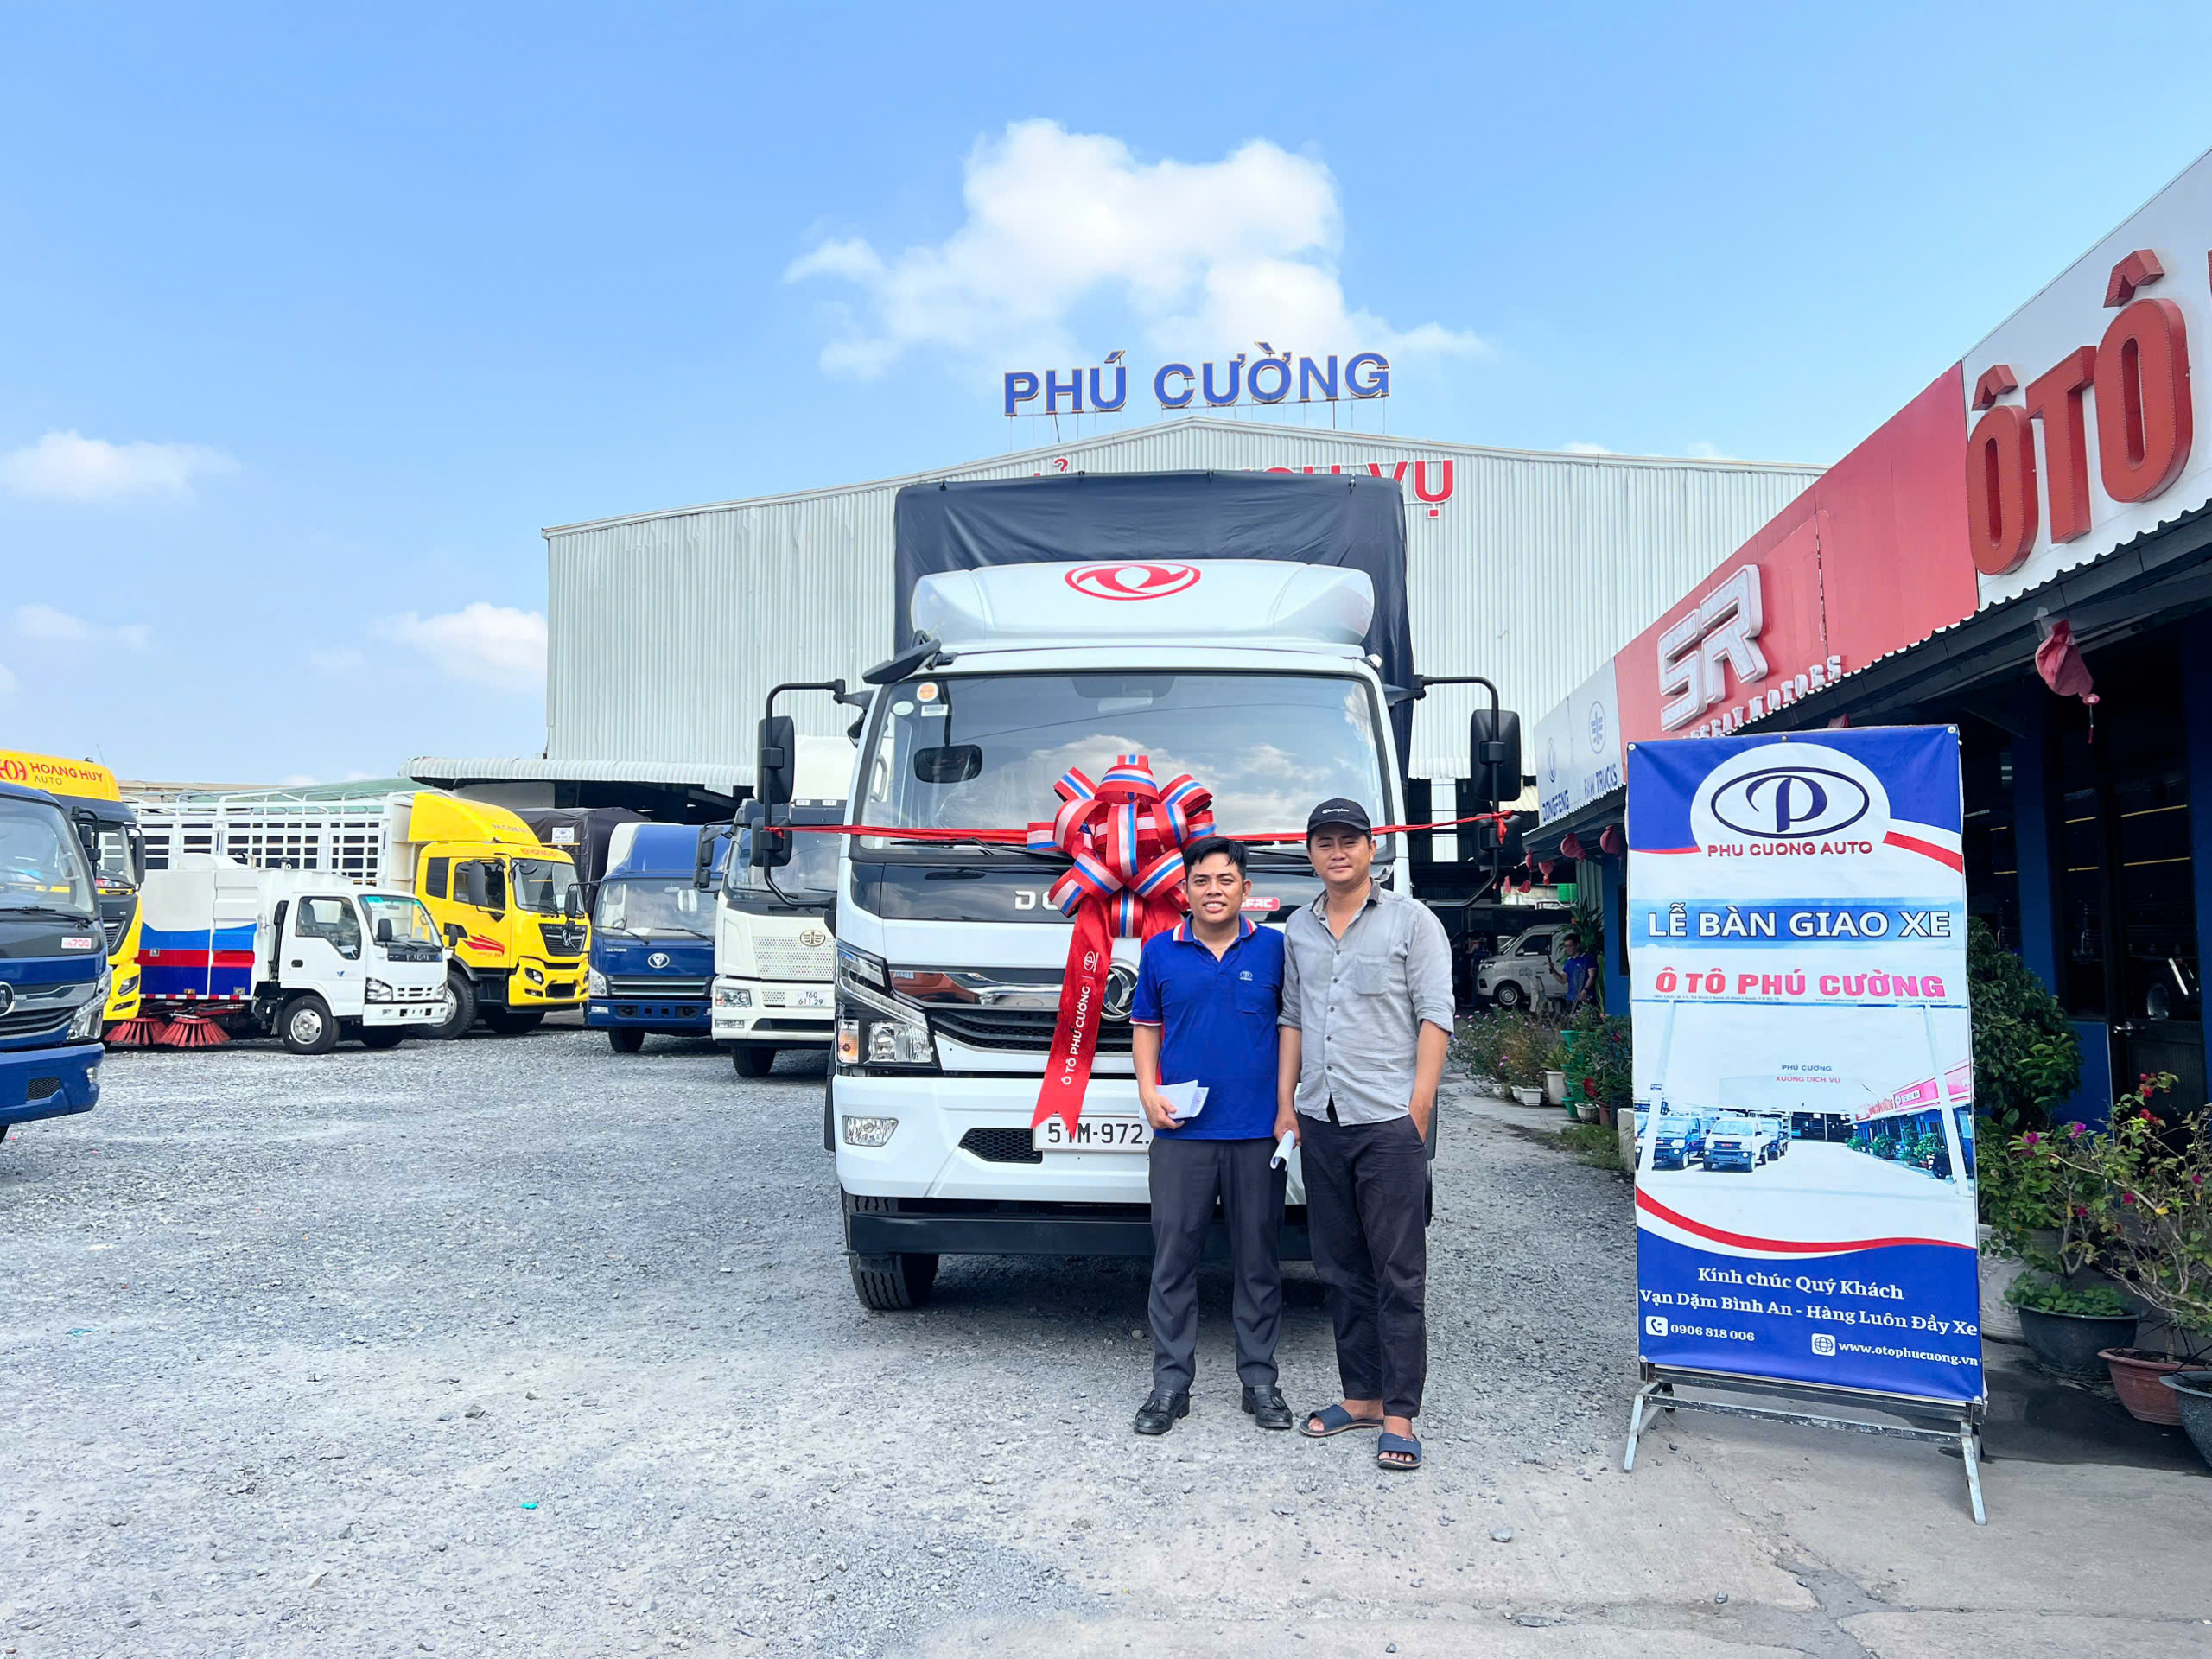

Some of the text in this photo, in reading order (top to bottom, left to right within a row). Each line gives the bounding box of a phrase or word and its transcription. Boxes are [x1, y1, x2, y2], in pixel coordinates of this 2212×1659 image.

[1003, 341, 1391, 417] PHÚ CƯỜNG
[35, 775, 63, 785] AUTO
[79, 769, 103, 783] HUY
[1595, 763, 1618, 793] TRUCKS
[1707, 840, 1873, 857] PHU CUONG AUTO
[1648, 902, 1951, 938] LỄ BÀN GIAO XE
[1655, 966, 1946, 997] Ô TÔ PHÚ CƯỜNG
[1075, 986, 1090, 1027] CƯỜNG
[1065, 1058, 1077, 1072] TÔ
[1061, 1077, 1071, 1085] Ô
[1697, 1267, 1904, 1300] Kính chúc Quý Khách
[1639, 1289, 1674, 1308] Vạn
[1676, 1293, 1718, 1312] Dặm
[1721, 1294, 1764, 1314] Bình
[1767, 1301, 1793, 1316] An
[1806, 1302, 1856, 1325] Hàng
[1859, 1308, 1908, 1329] Luôn
[1911, 1313, 1948, 1336] Đầy
[1952, 1320, 1979, 1337] Xe
[1670, 1324, 1756, 1342] 0906 818 006
[1838, 1340, 1979, 1367] www.otophucuong.vn
